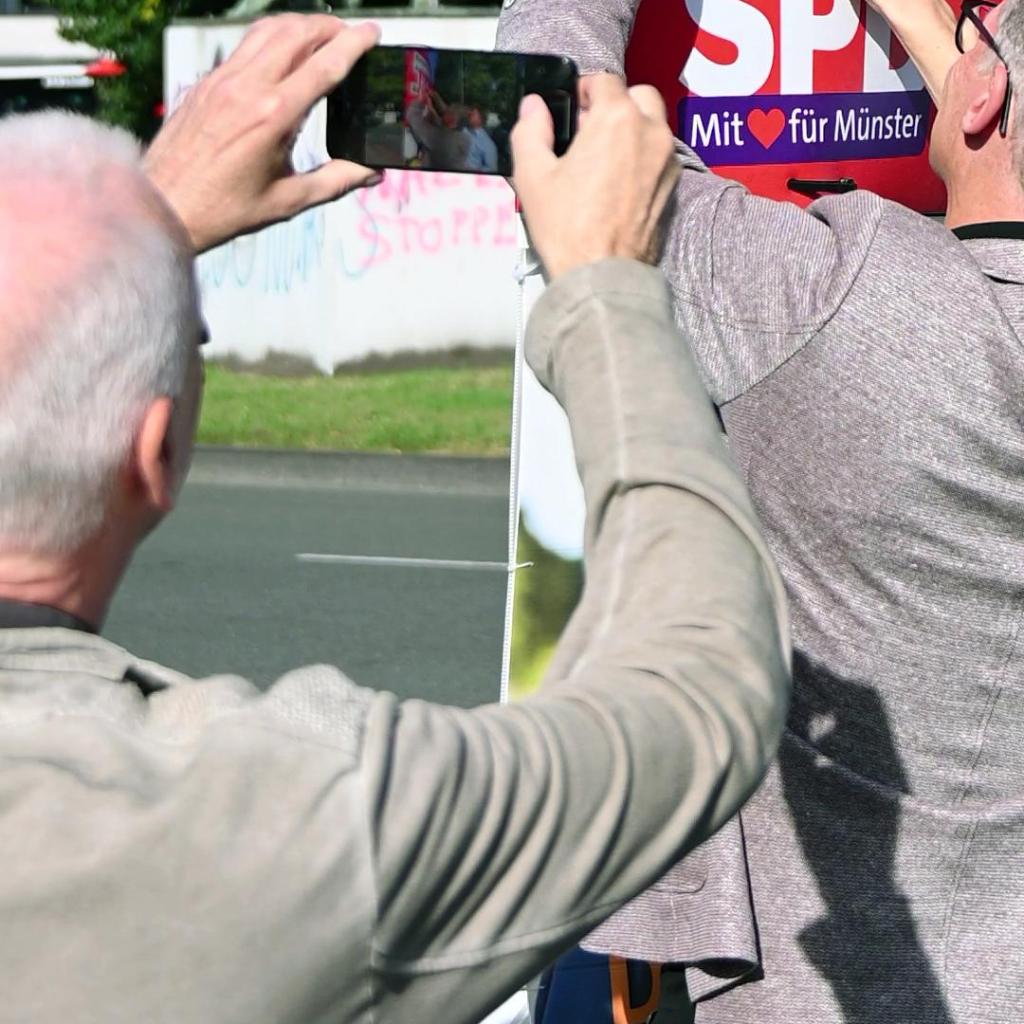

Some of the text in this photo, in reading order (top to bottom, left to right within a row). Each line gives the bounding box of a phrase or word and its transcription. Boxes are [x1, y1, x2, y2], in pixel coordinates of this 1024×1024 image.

[690, 107, 922, 148] Mit für Münster
